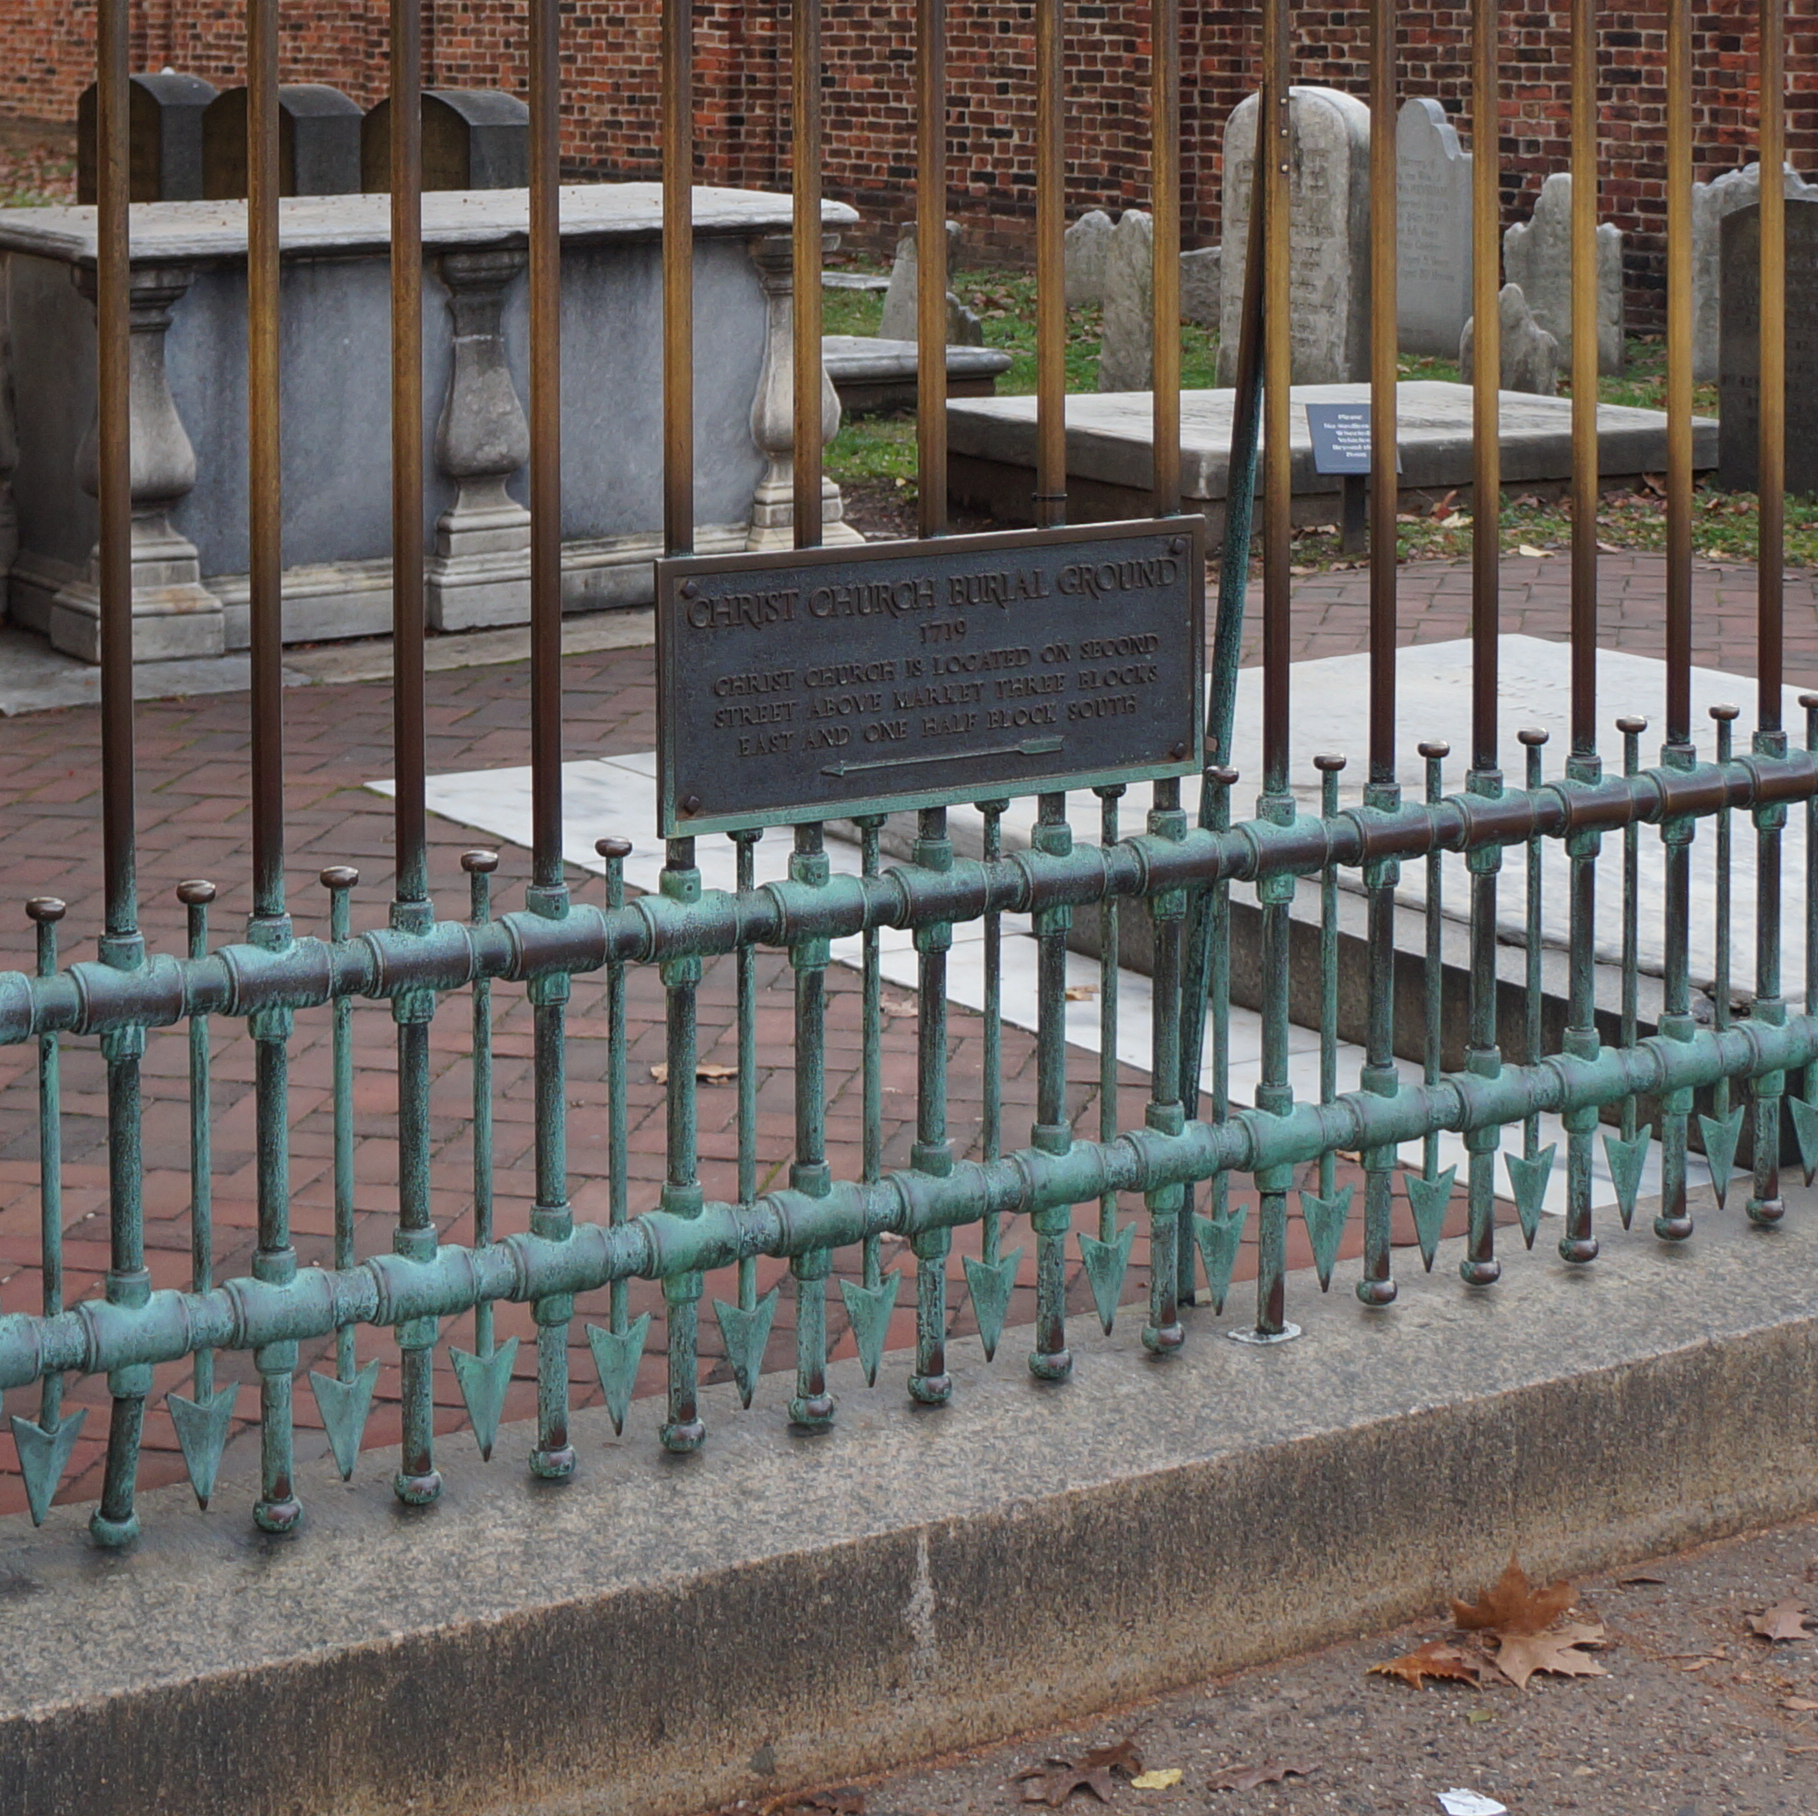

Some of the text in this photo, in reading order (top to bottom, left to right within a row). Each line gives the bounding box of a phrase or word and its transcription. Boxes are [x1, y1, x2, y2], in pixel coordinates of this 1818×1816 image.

[686, 556, 1179, 630] CHRIST CHURCH BURIAL GROUND
[919, 618, 968, 645] 1719
[713, 632, 1161, 698] CHRIST CHURCH IS LOCATED ON SECOND
[714, 663, 1161, 730] STREET ABOVE MARKET THREE BLOCKS
[737, 694, 1138, 759] EAST AND ONE HALF BLOCK SOUTH
